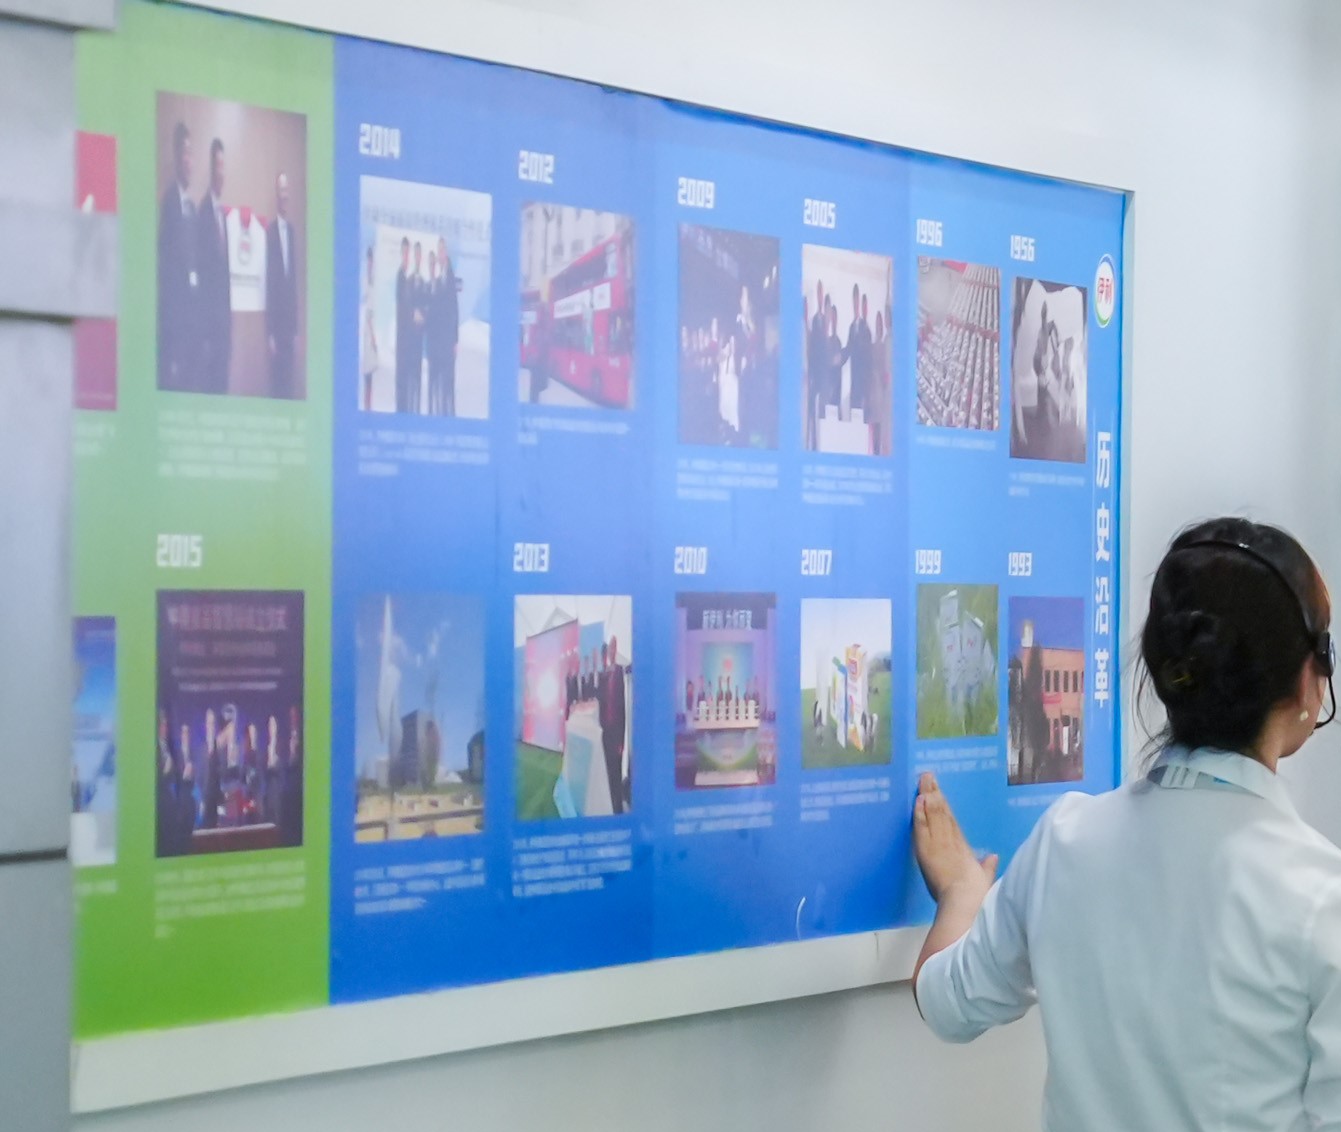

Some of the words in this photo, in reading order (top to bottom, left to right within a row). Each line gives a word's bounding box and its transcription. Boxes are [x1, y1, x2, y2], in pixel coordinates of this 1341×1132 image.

[358, 124, 401, 159] 2014
[518, 149, 555, 184] 2012
[677, 176, 716, 209] 2009
[803, 198, 836, 229] 2005
[916, 218, 943, 247] 1996
[1010, 234, 1035, 262] 1956
[156, 533, 203, 568] 2015
[513, 542, 550, 573] 2013
[673, 545, 708, 575] 2010
[800, 548, 833, 576] 2007
[915, 549, 942, 575] 1999
[1008, 552, 1033, 577] 1993
[1093, 431, 1113, 709] 历史沿革
